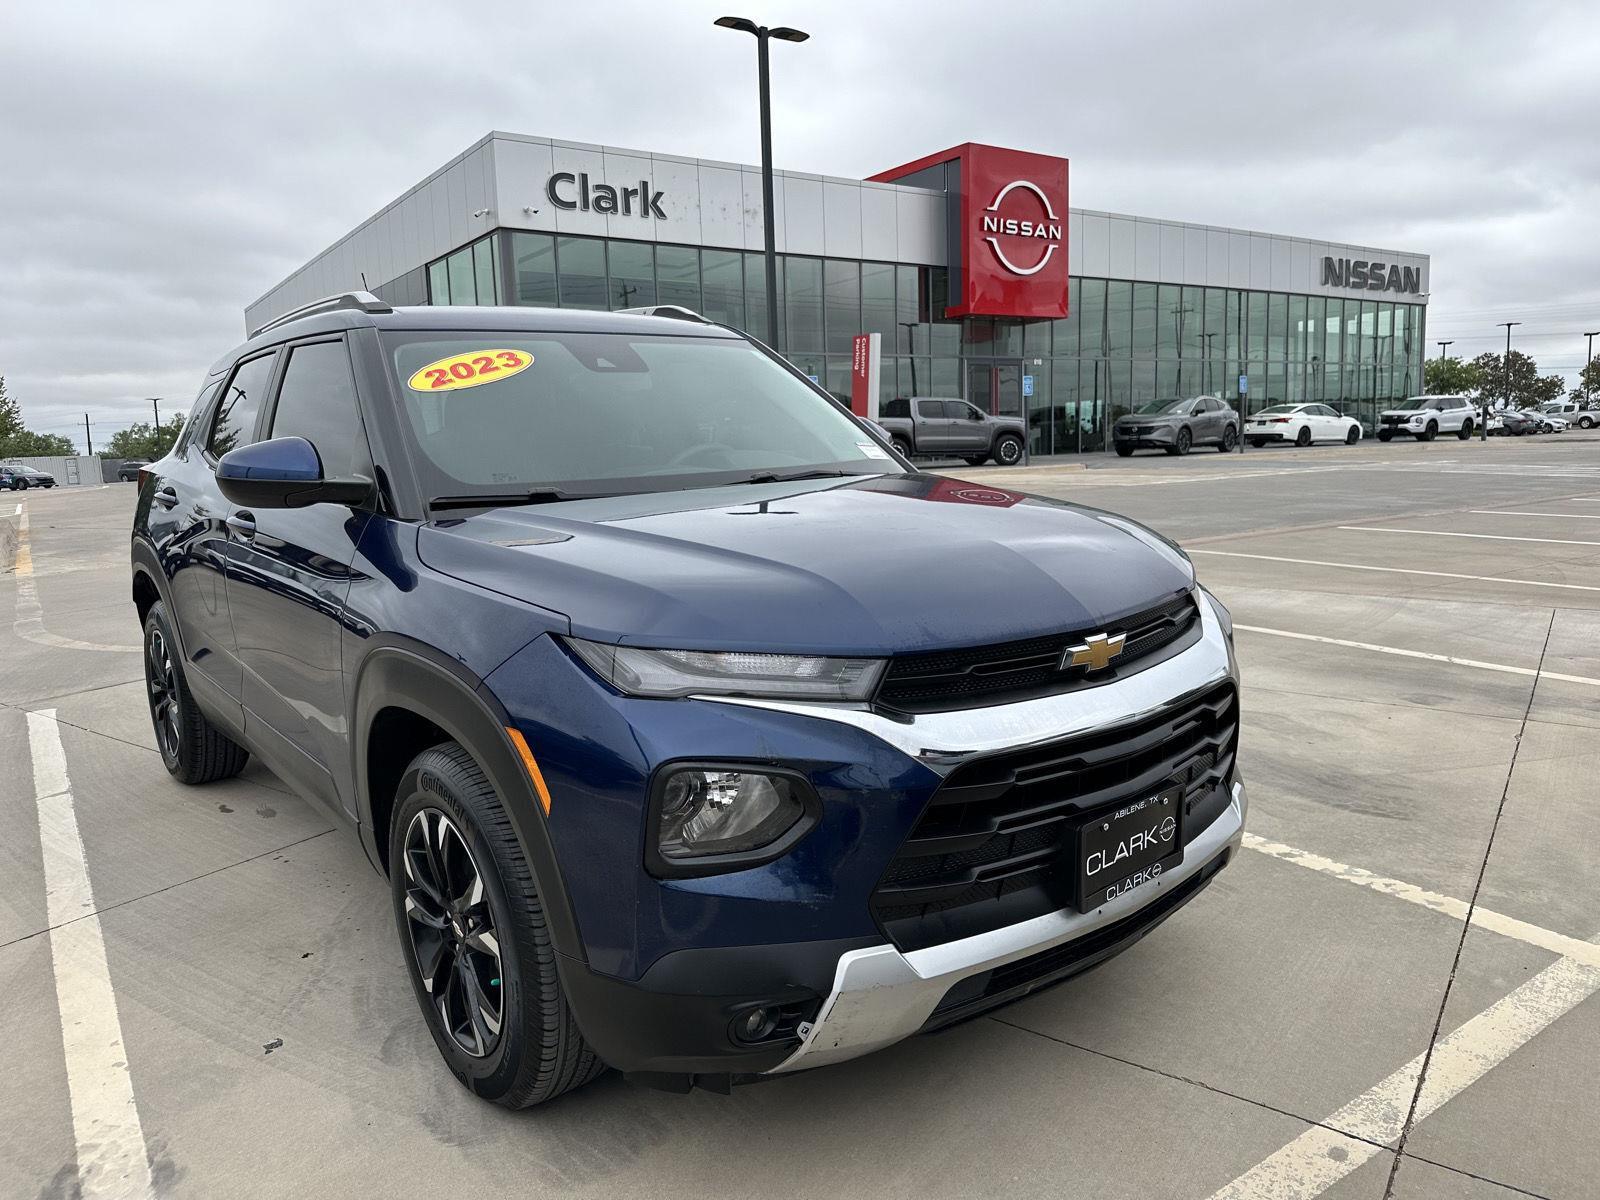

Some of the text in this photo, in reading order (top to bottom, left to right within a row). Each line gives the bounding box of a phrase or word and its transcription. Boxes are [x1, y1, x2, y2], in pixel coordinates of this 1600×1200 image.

[546, 171, 667, 220] Clark
[983, 215, 1062, 240] NISSAN
[1321, 256, 1420, 294] NISSAN
[424, 351, 523, 389] 2023
[1114, 796, 1159, 820] ABILENE, TX
[1086, 825, 1158, 876] CLARK
[1106, 867, 1152, 901] CLARK
